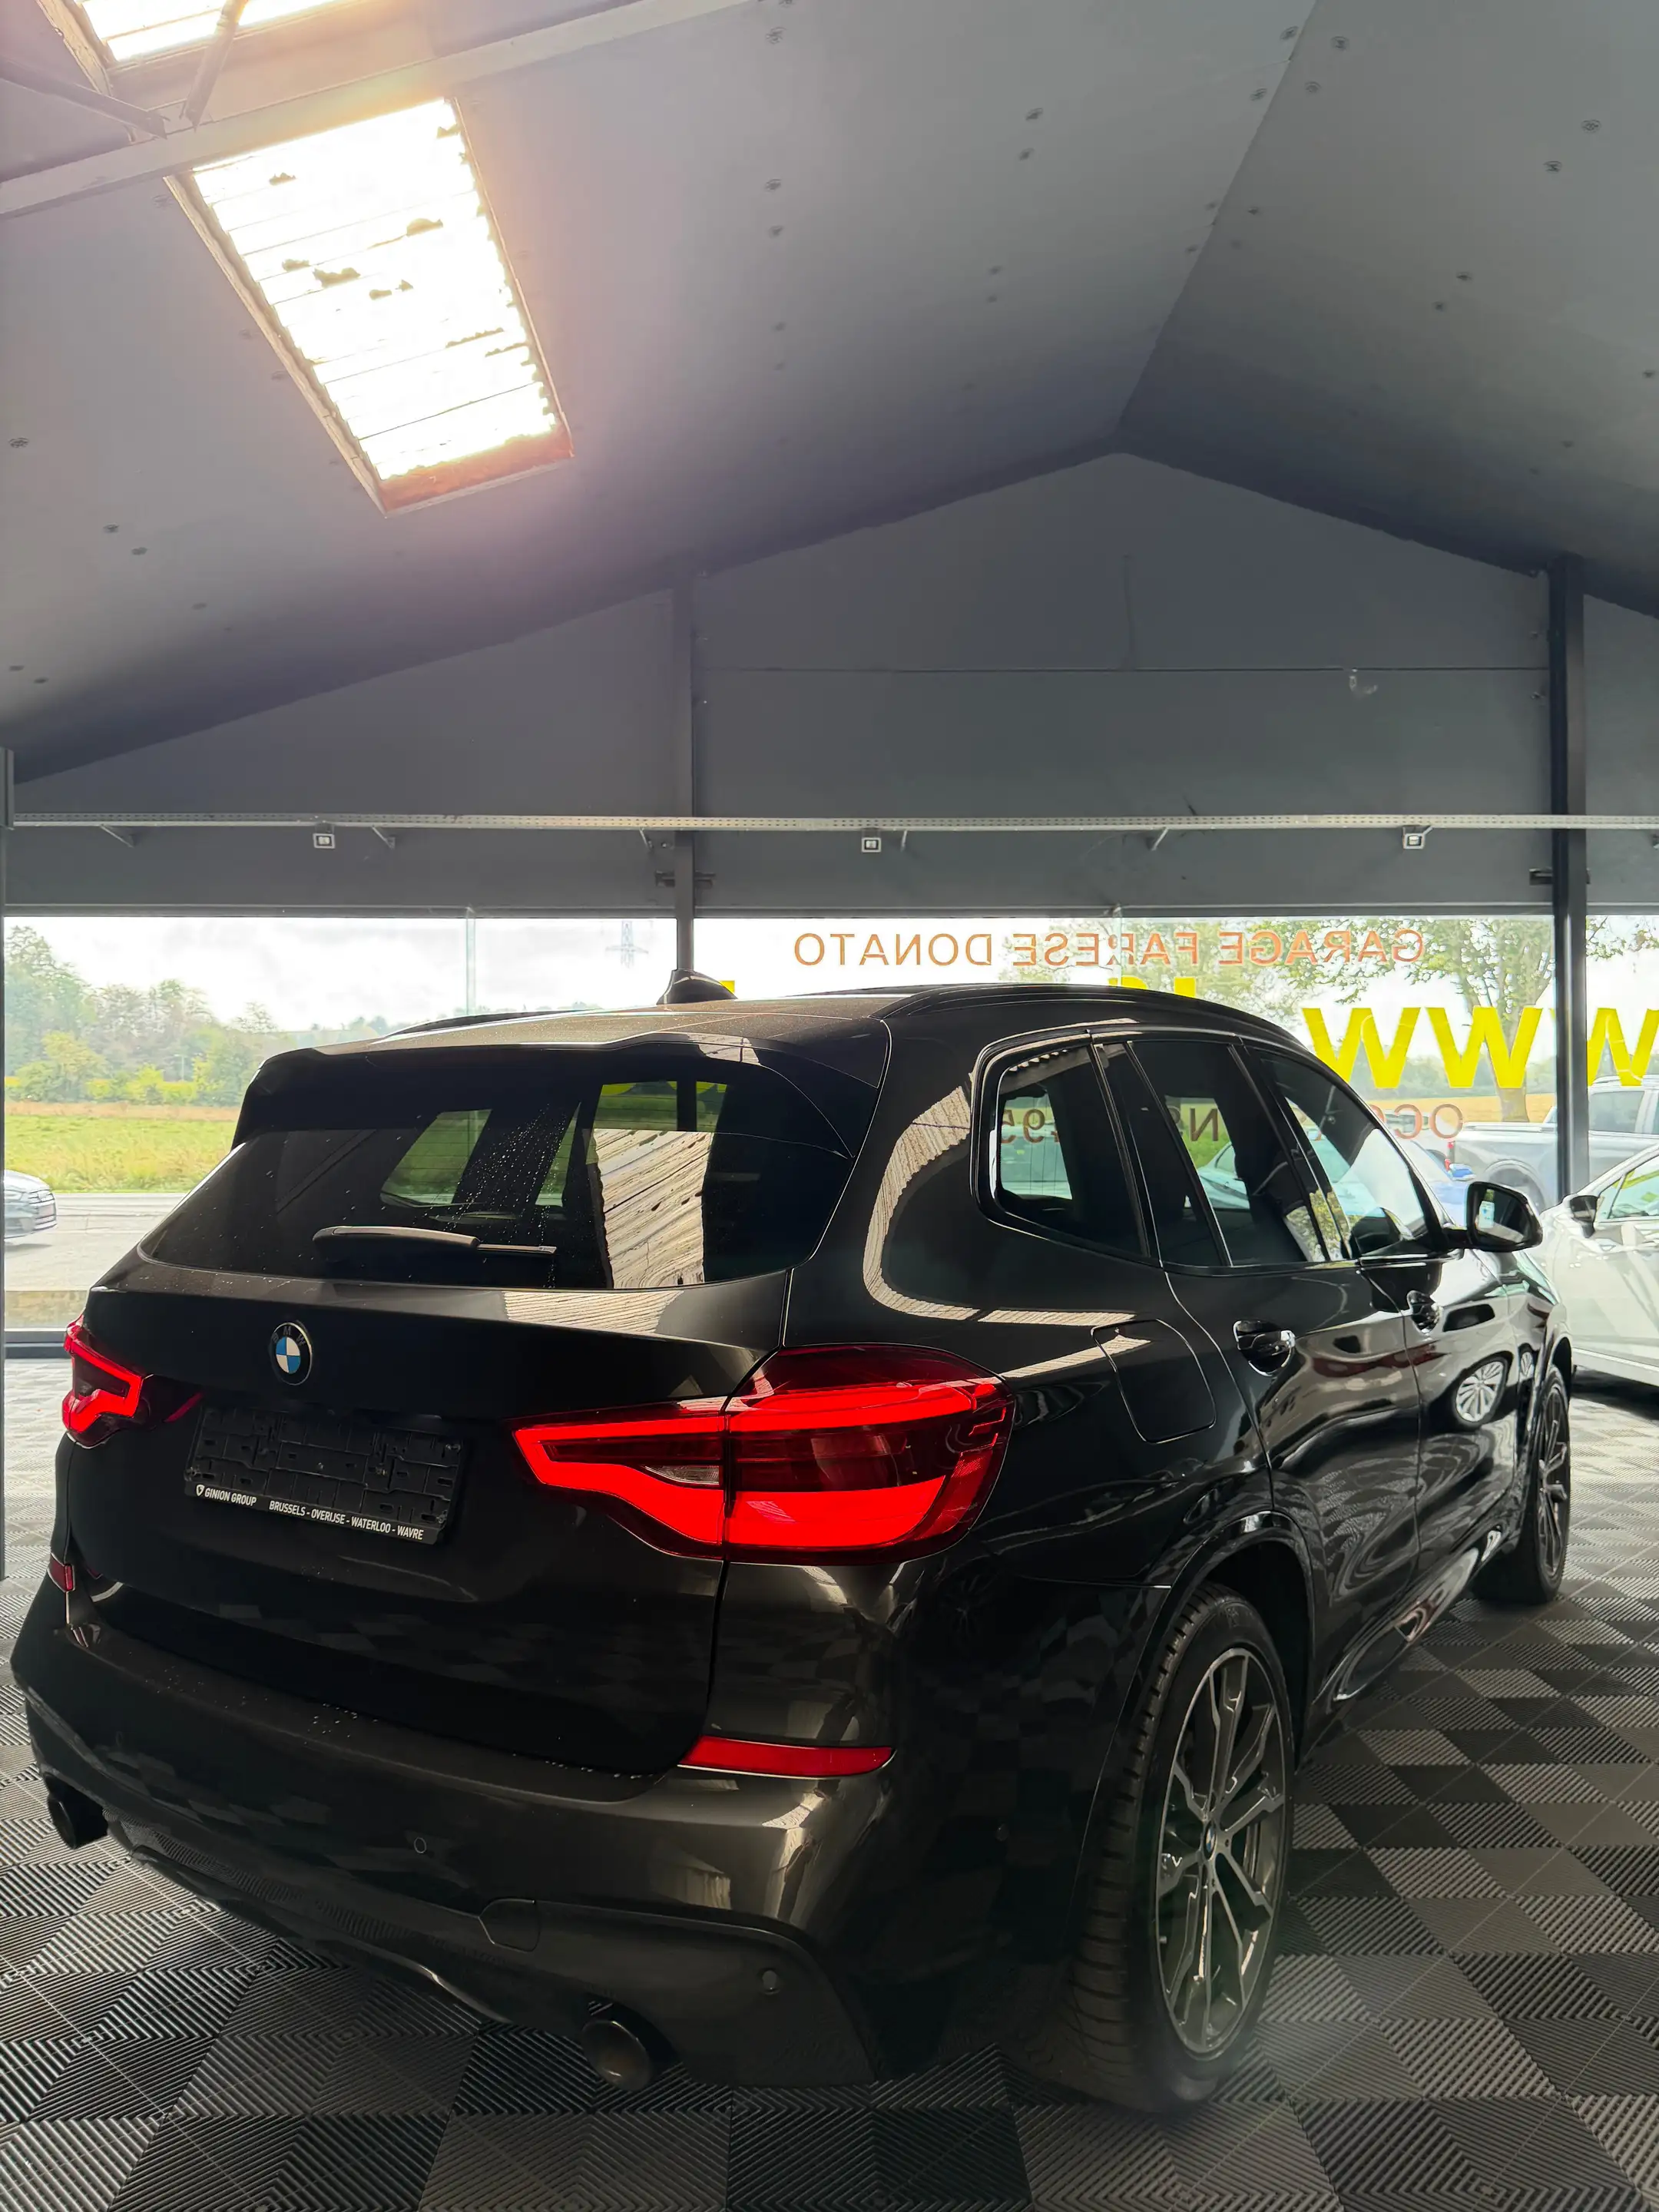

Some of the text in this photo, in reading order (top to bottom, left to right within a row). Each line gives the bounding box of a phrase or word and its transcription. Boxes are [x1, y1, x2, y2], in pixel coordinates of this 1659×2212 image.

[204, 1488, 257, 1507] GINION GROUP
[269, 1500, 306, 1517] BRUSSELS
[311, 1509, 346, 1524] OVERIJSE
[351, 1516, 391, 1534] WATERLOO
[397, 1525, 424, 1540] WAVRE
